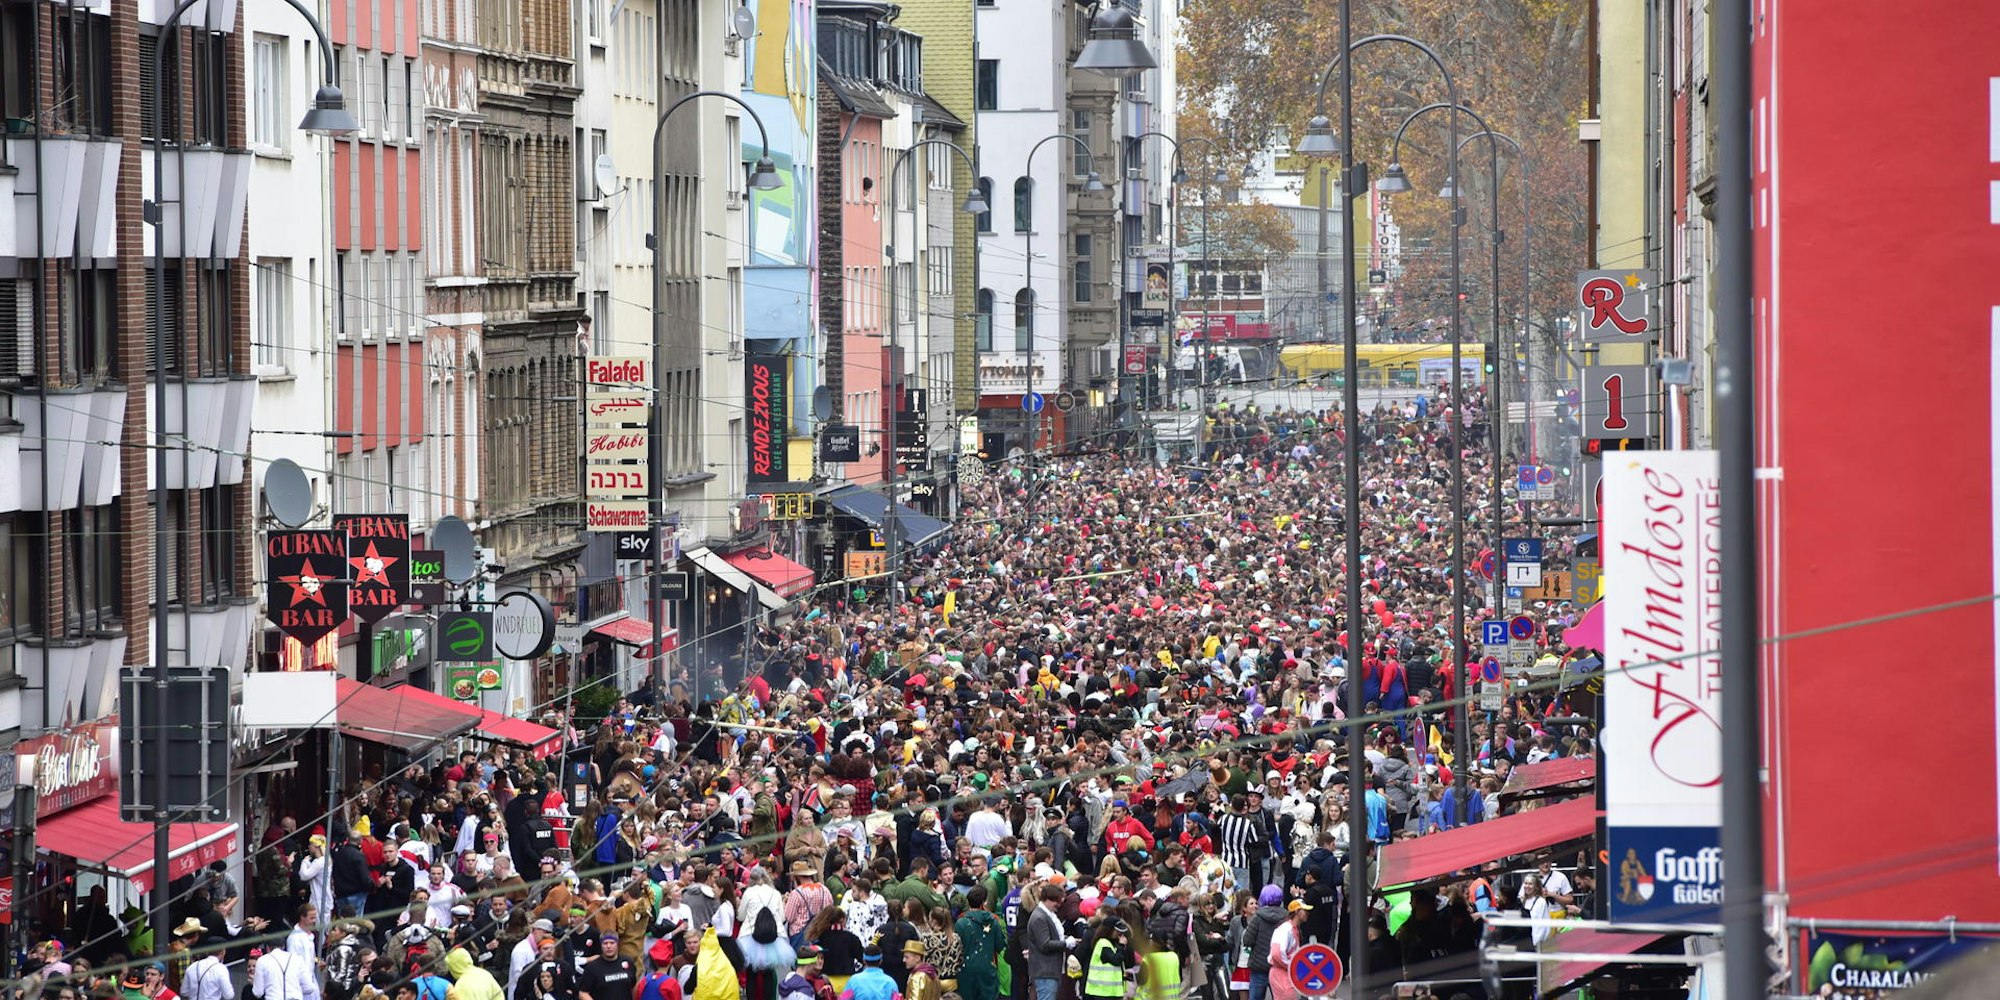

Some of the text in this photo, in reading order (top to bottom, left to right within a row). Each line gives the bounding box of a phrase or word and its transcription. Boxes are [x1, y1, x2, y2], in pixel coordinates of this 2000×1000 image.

[1581, 277, 1648, 334] R
[589, 360, 644, 382] Falafel
[591, 397, 644, 416] حبيبي
[1603, 374, 1627, 429] 1
[752, 364, 771, 476] RENDEZVOUS
[773, 373, 782, 470] CAFE BAR RESTAURANT
[589, 433, 644, 454] Habibi
[591, 472, 643, 488] ברכה
[913, 484, 934, 496] sky
[589, 505, 647, 527] Schawarma
[269, 533, 345, 558] CUBANA
[621, 534, 650, 552] sky
[350, 588, 397, 606] BAR
[282, 609, 335, 627] BAR
[1489, 624, 1503, 644] P
[536, 830, 551, 839] SWAT
